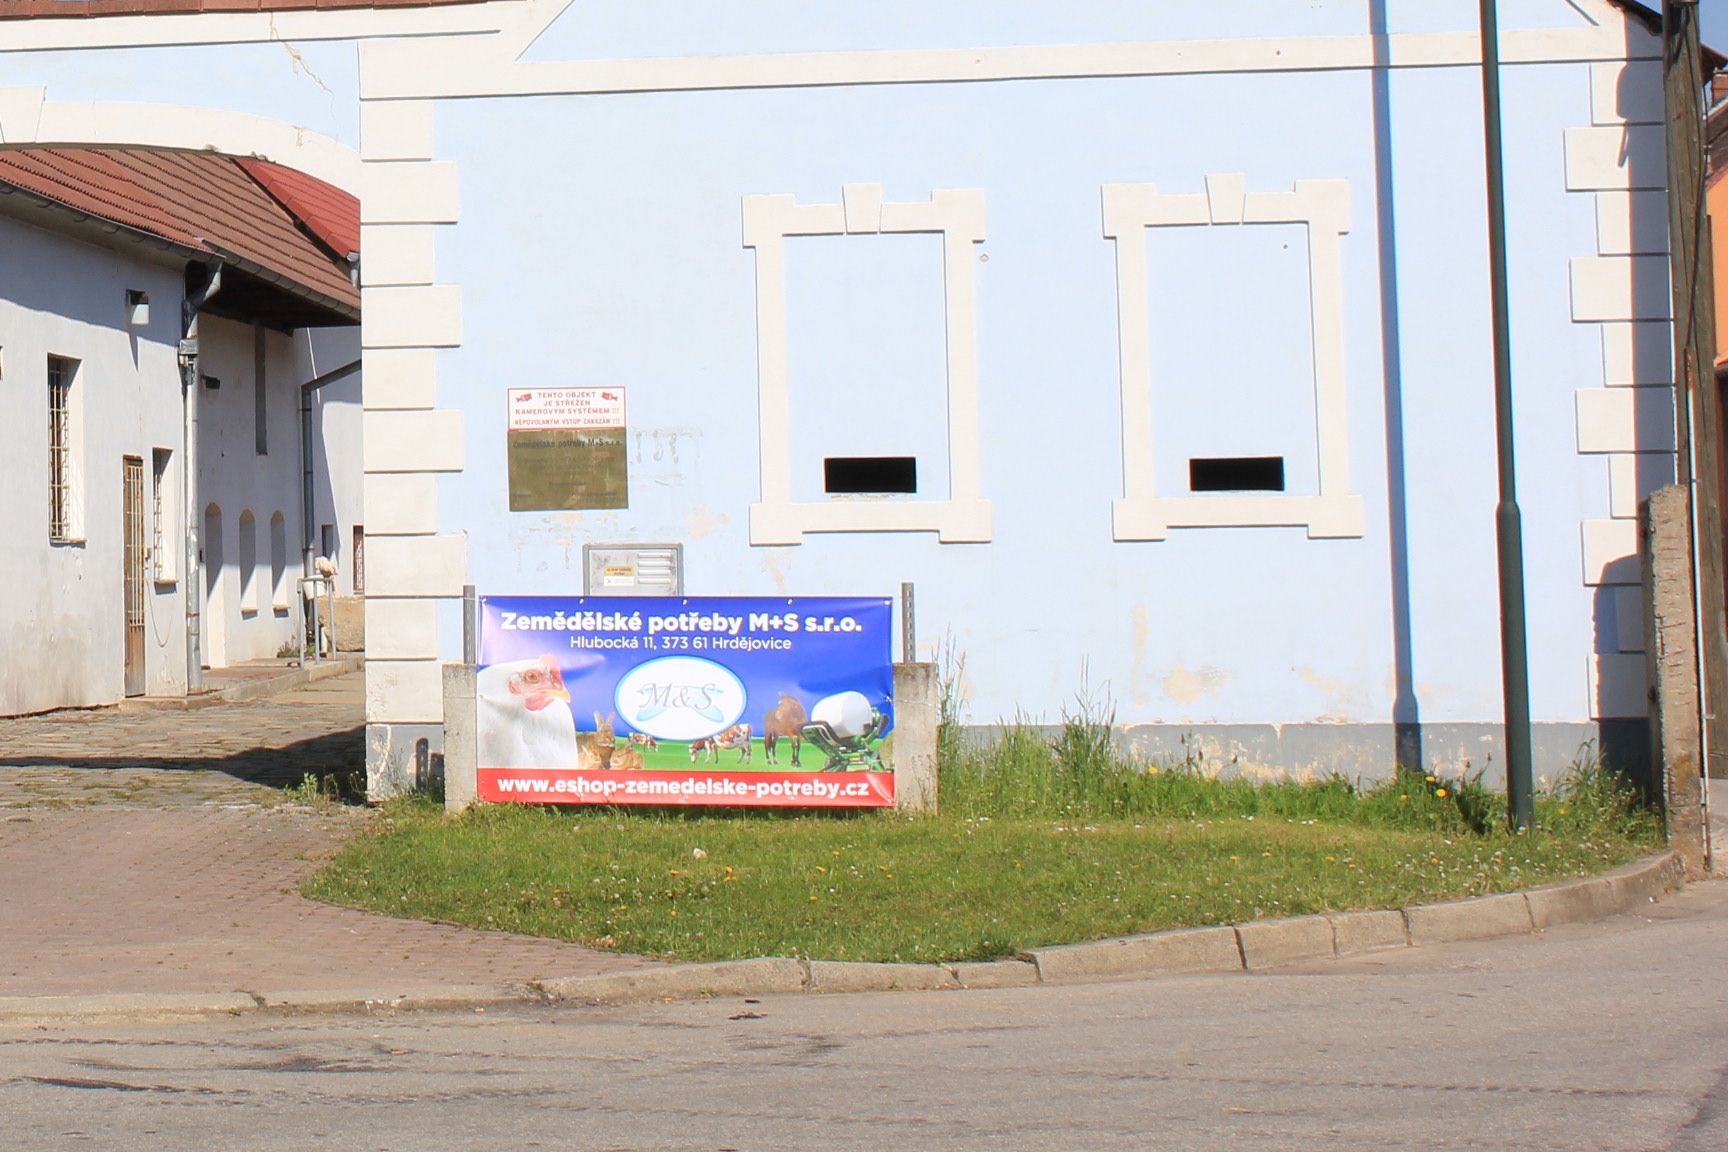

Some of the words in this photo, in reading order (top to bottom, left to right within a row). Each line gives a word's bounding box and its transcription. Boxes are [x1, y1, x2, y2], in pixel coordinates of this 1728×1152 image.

[501, 611, 643, 631] Zemědělské
[648, 611, 743, 635] potřeby
[749, 613, 799, 632] M+S
[805, 616, 862, 632] s.r.o.
[570, 635, 639, 649] Hlubocká
[643, 636, 657, 650] 11,
[662, 636, 689, 649] 373
[692, 636, 708, 649] 61
[712, 636, 792, 651] Hrdějovice
[497, 776, 870, 798] www.eshop-zemedelske-potreby.cz
